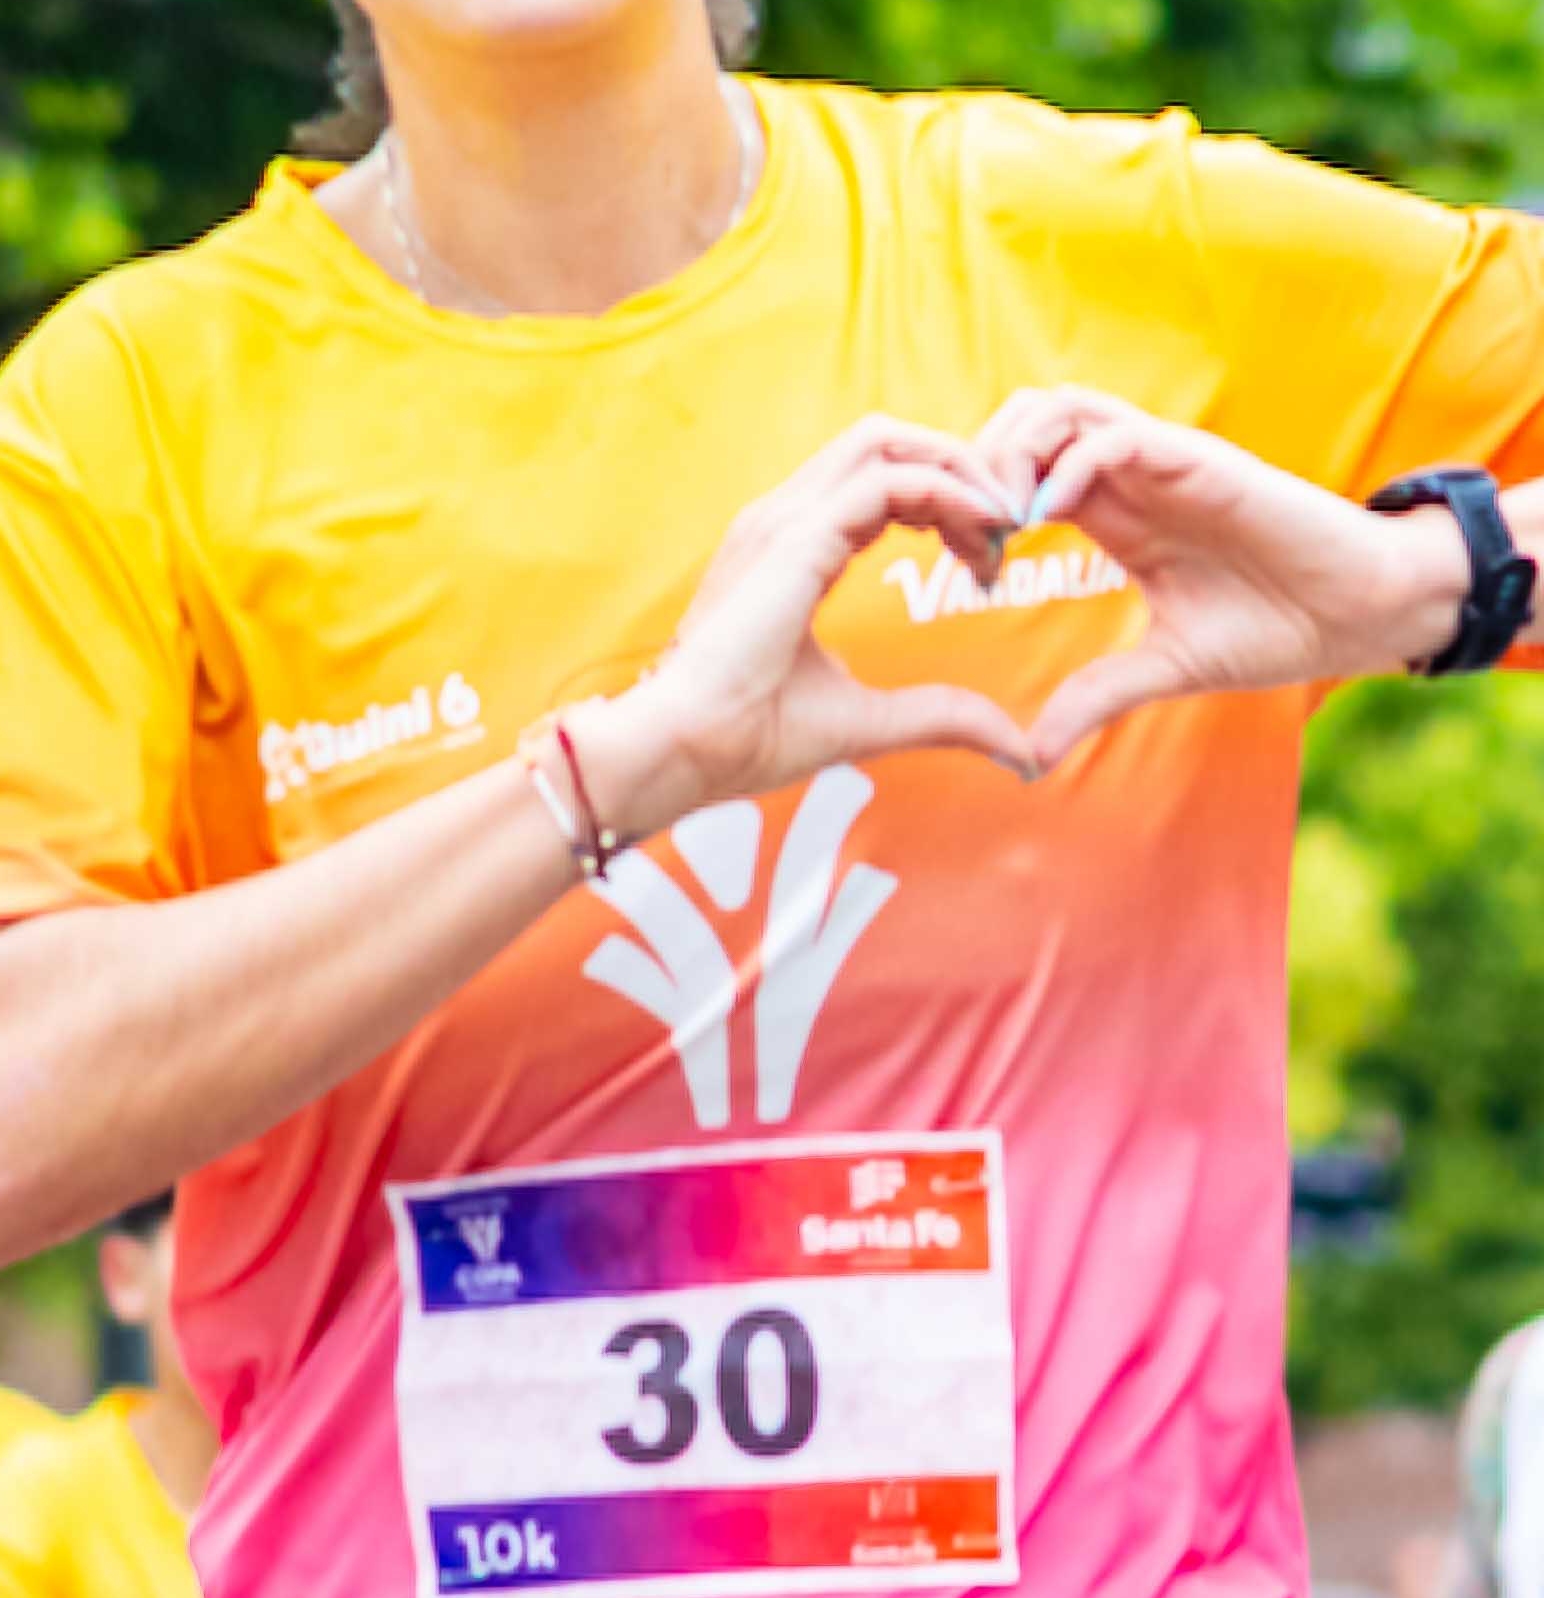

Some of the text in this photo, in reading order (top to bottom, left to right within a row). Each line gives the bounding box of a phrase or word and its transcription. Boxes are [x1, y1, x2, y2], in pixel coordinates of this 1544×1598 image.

[438, 671, 481, 727] 6
[600, 1308, 818, 1465] 30
[458, 1517, 557, 1579] 10k
